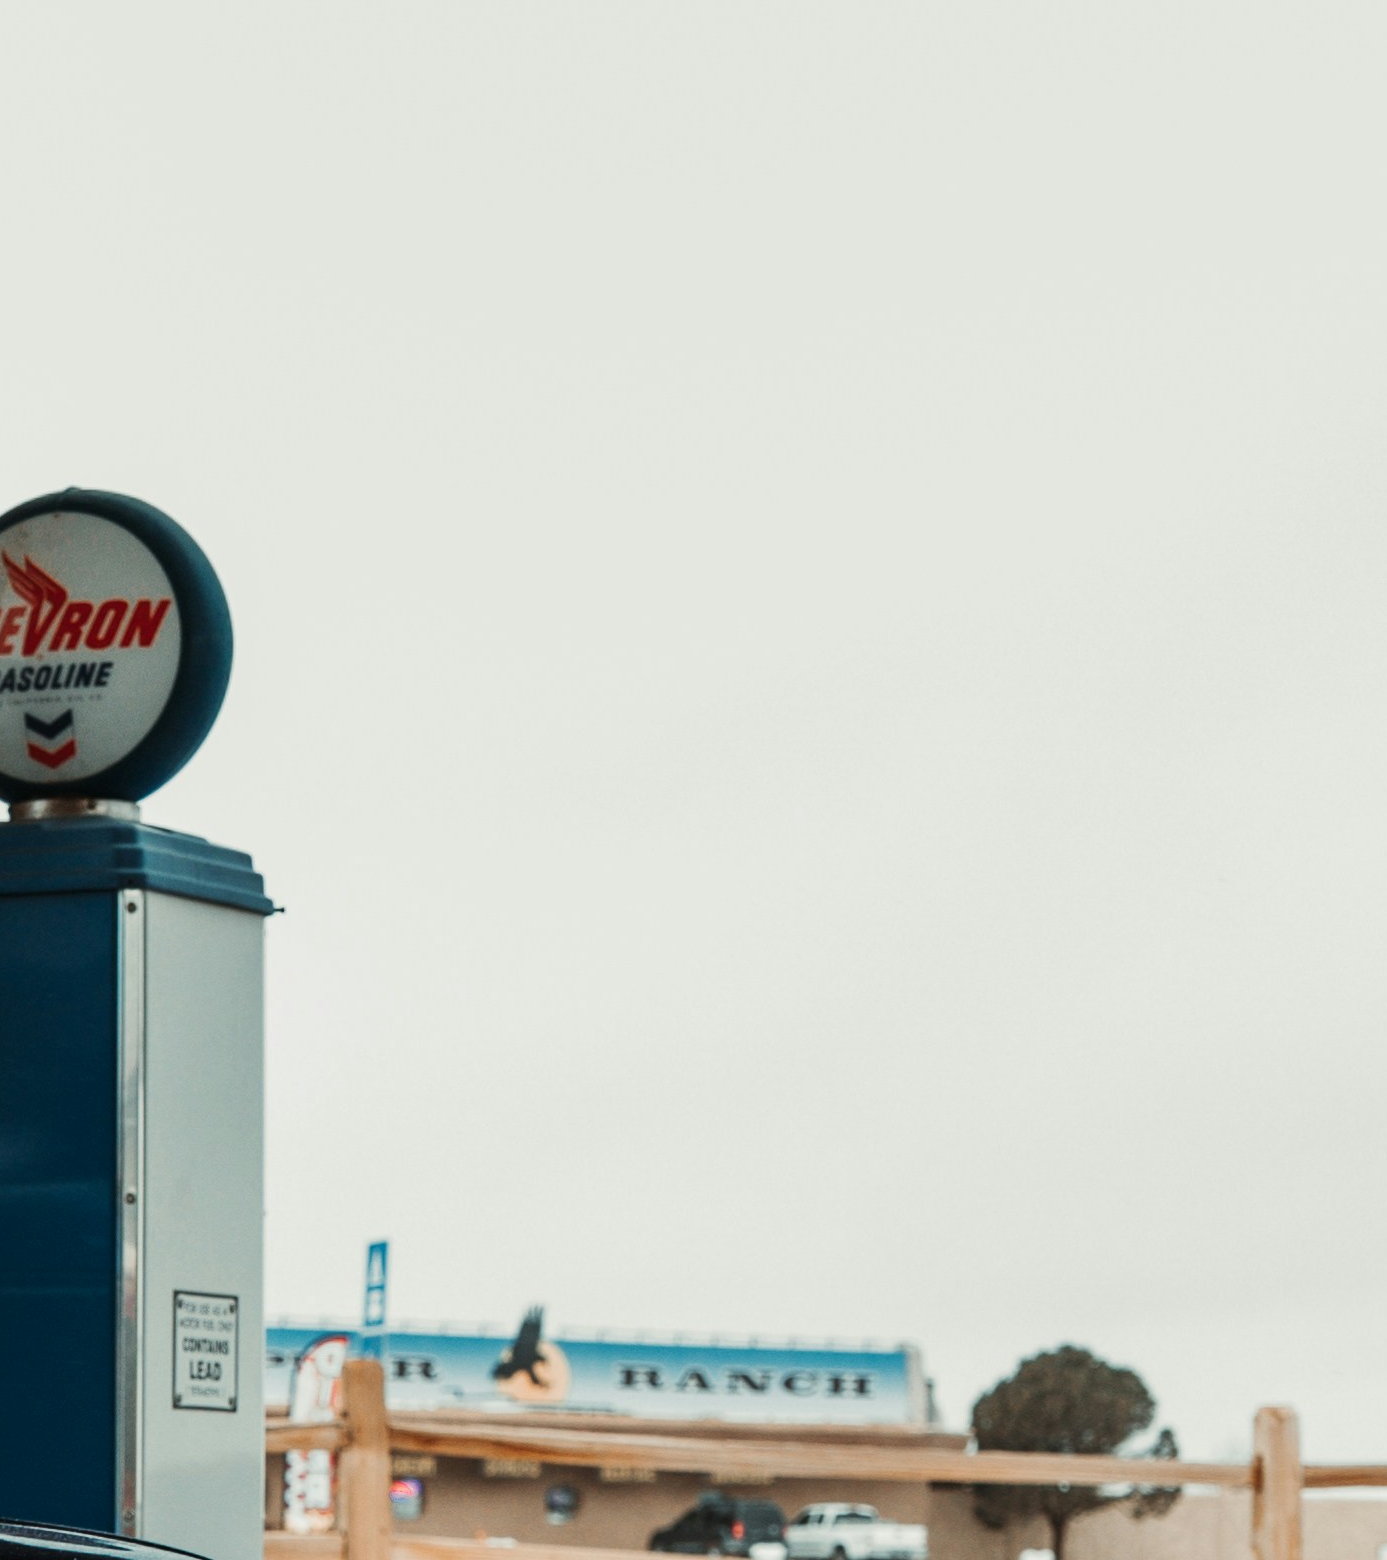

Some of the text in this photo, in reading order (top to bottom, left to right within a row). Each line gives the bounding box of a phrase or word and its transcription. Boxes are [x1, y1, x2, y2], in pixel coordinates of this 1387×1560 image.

[182, 1337, 230, 1356] CONTAINS
[189, 1360, 222, 1381] LEAD
[618, 1363, 876, 1398] RANCH
